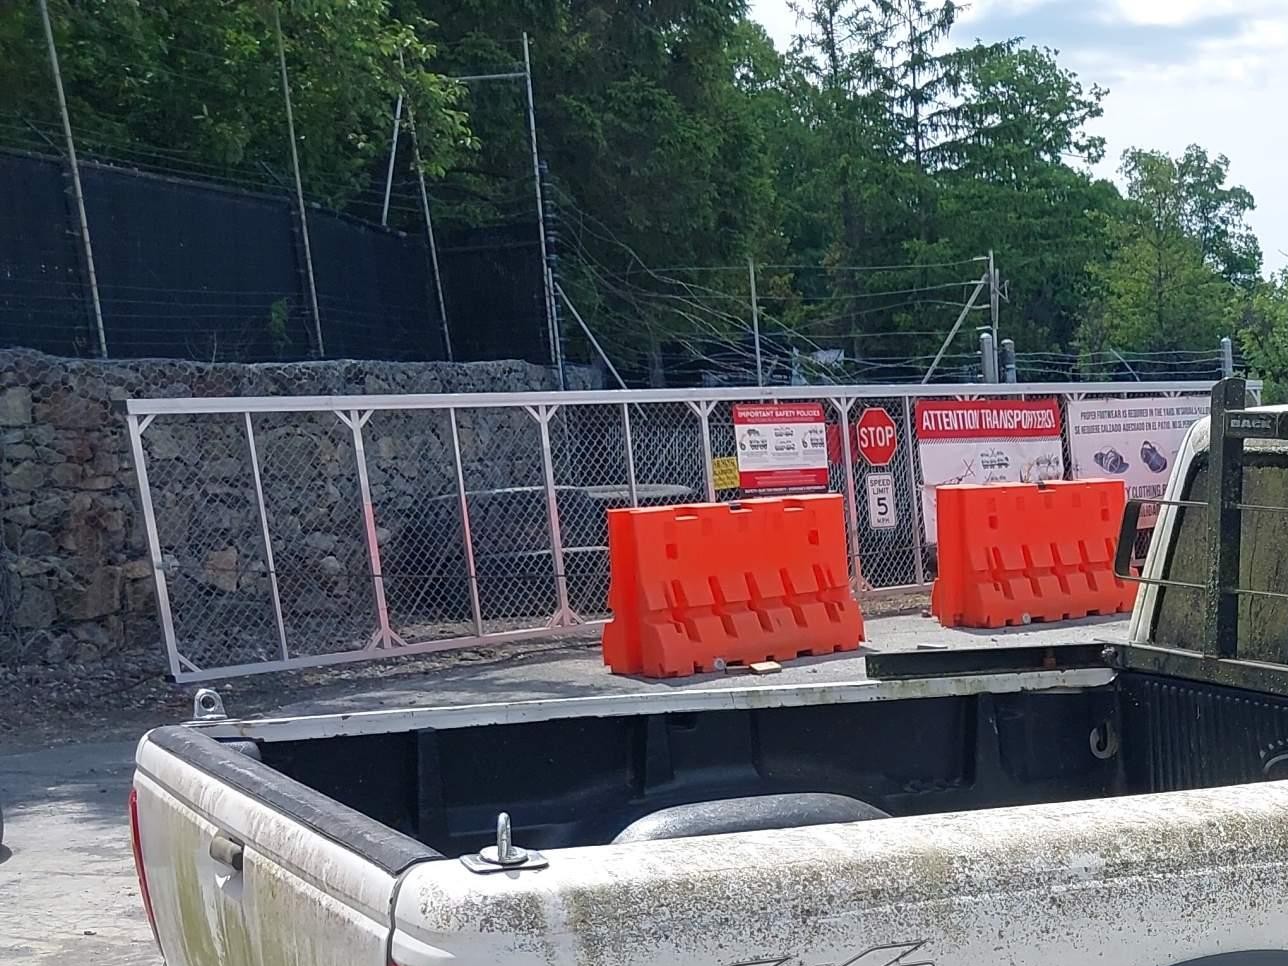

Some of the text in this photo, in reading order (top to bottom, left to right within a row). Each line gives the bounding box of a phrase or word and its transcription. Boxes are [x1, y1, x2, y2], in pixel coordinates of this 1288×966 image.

[737, 410, 773, 418] IMPORTANT
[796, 409, 820, 417] POLICIES
[922, 408, 1056, 430] ATTENTION TRANSPORTERS!
[1081, 411, 1096, 420] PROPER
[1097, 409, 1121, 419] FOOTWEAR
[1122, 409, 1127, 418] IS
[1128, 408, 1148, 418] REQUIRED
[1149, 408, 1154, 417] IN
[1155, 407, 1163, 417] THE
[1075, 425, 1080, 435] SE
[1081, 424, 1100, 434] REQUIERE
[1101, 423, 1121, 433] CALZADO
[1146, 421, 1152, 431] EN
[1152, 421, 1157, 430] EL
[1230, 418, 1271, 430] BACK
[860, 425, 894, 448] STOP
[869, 479, 890, 488] SPEED
[872, 487, 889, 495] LIMIT
[1132, 484, 1160, 498] CLOTHING
[876, 496, 888, 516] 5
